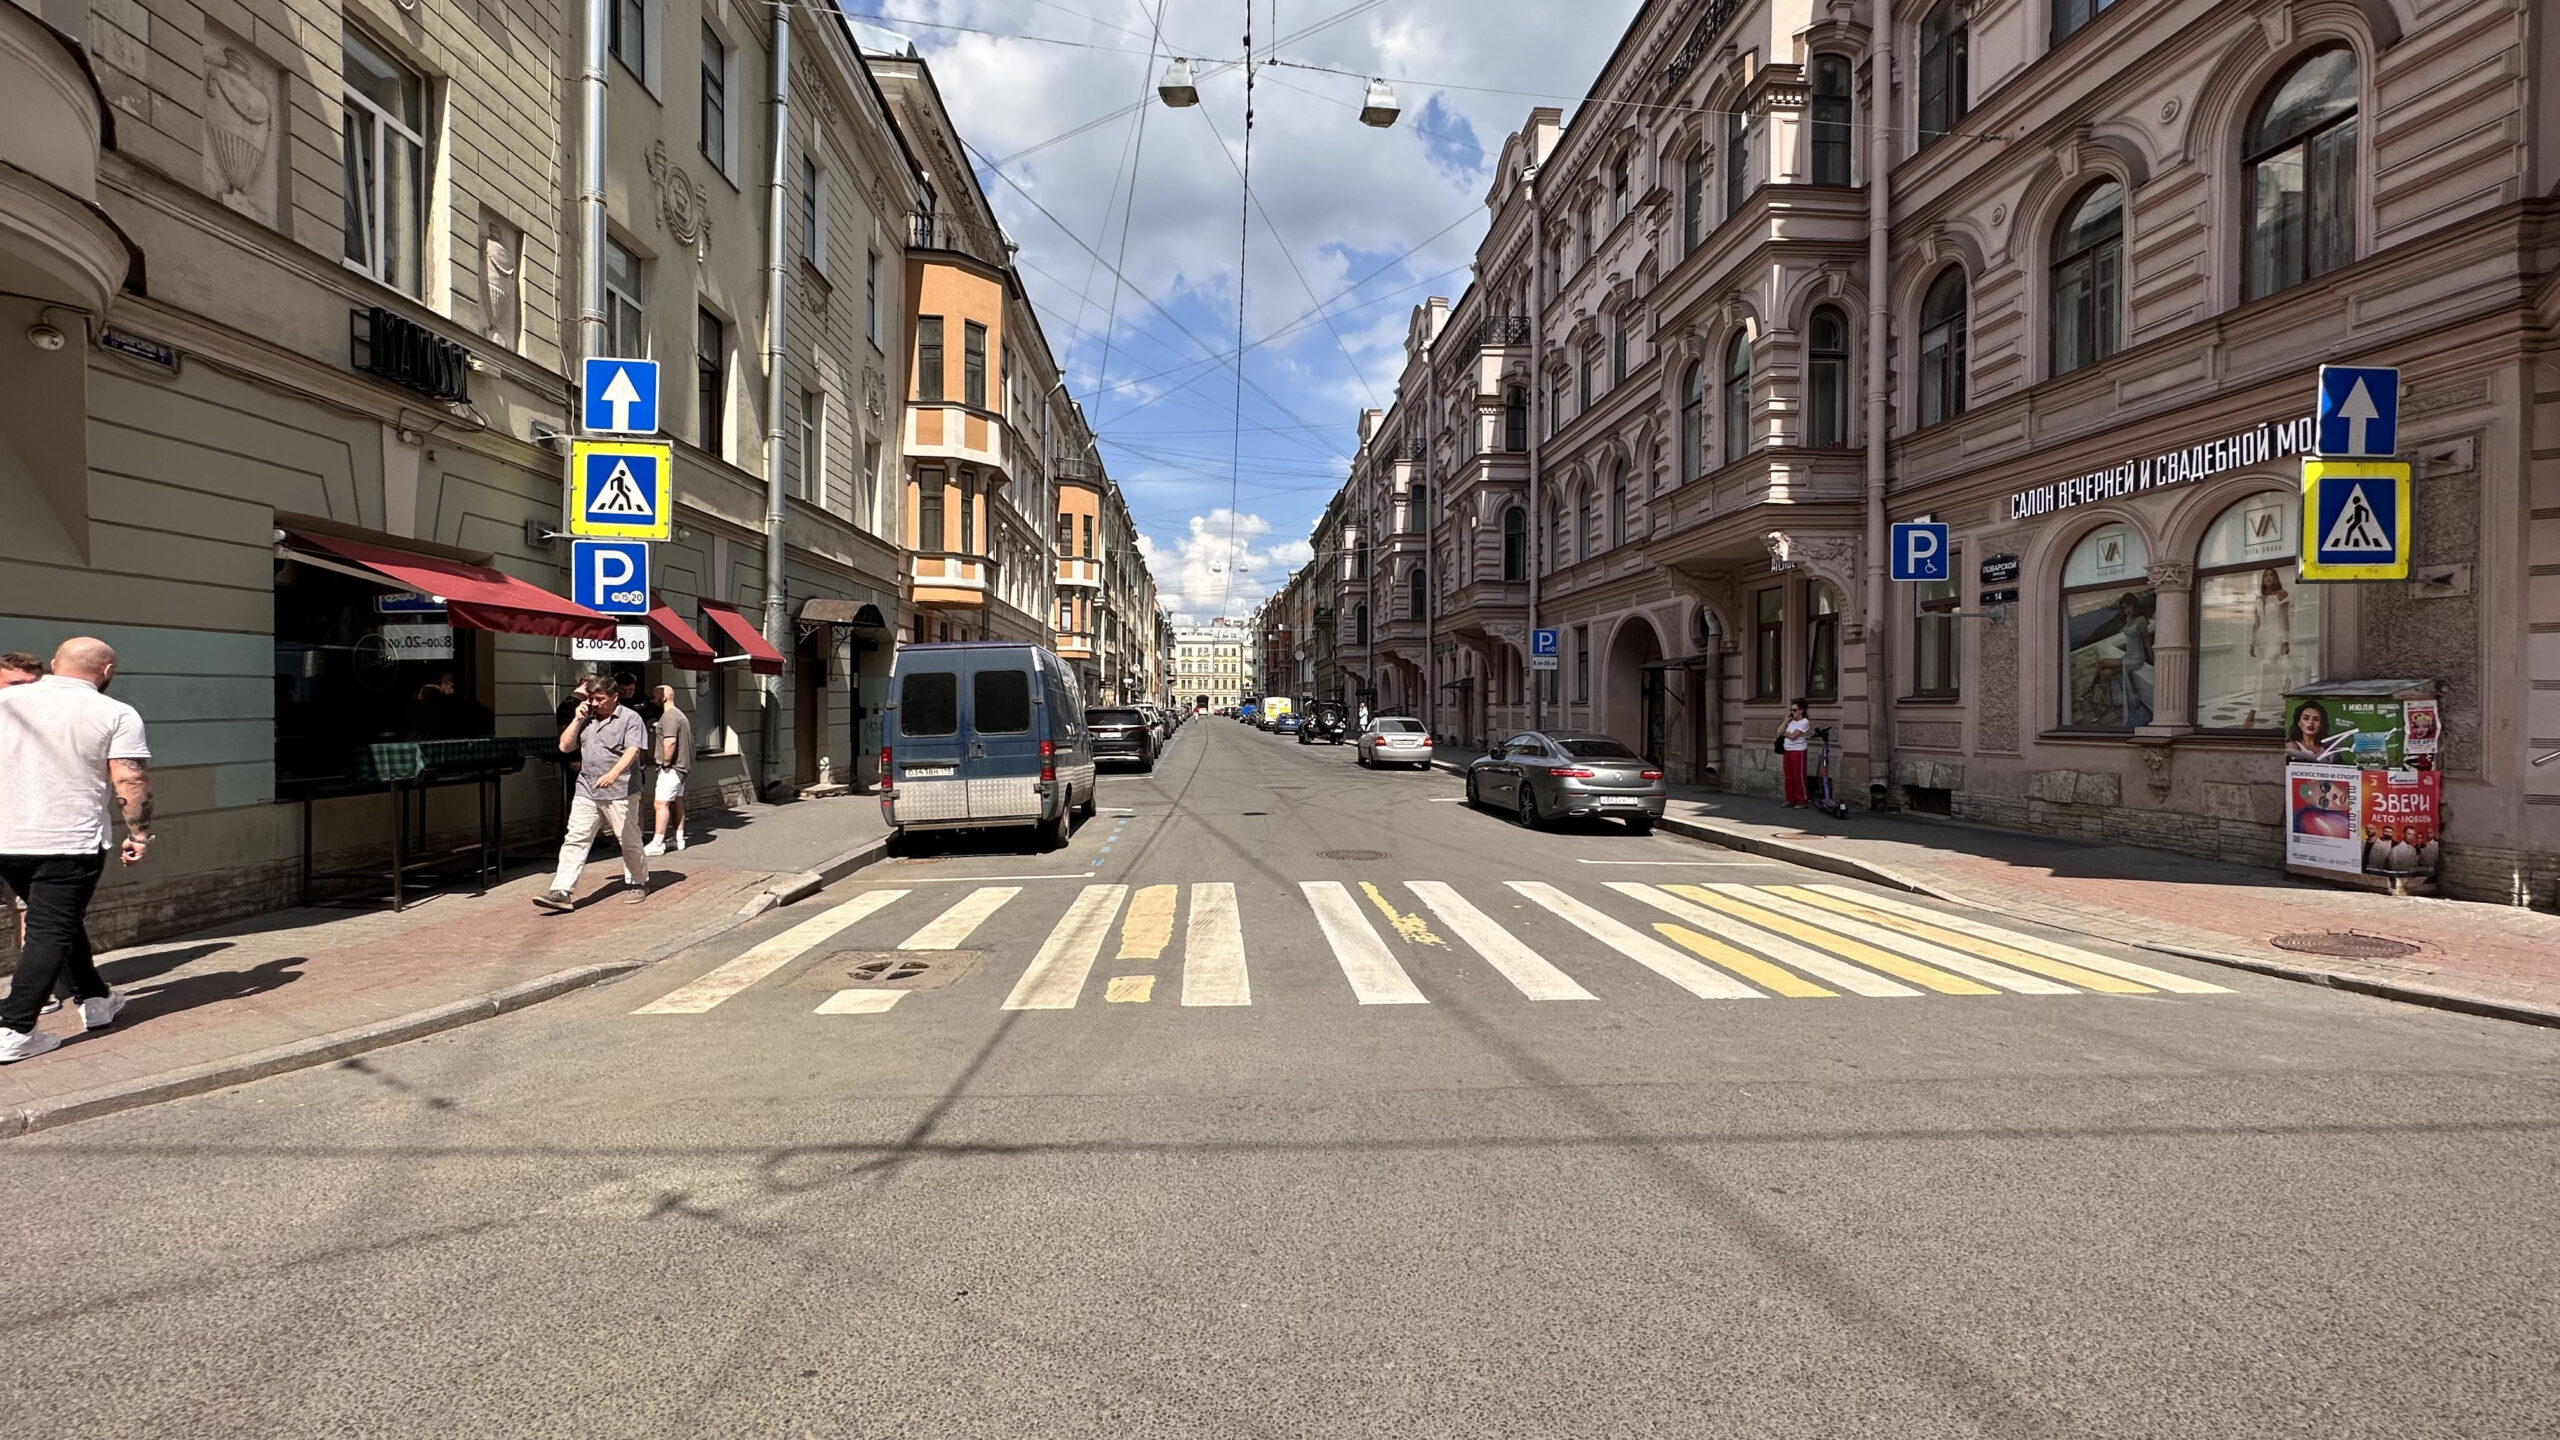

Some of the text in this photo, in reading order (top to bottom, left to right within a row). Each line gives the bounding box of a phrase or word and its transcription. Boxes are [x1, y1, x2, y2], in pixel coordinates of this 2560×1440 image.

[2011, 417, 2316, 520] САЛОН ВЕЧЕРНЕЙ И СВАДЕБНОЙ МО
[1908, 530, 1938, 574] P
[594, 549, 634, 605] P
[631, 593, 643, 602] 20
[1994, 592, 2002, 600] 14
[576, 638, 646, 650] 8.00-20.00
[1539, 632, 1553, 652] P
[2348, 703, 2375, 711] ИЮЛЯ
[2371, 792, 2430, 812] ЗВЕРИ
[2371, 813, 2395, 823] ЛЕТО
